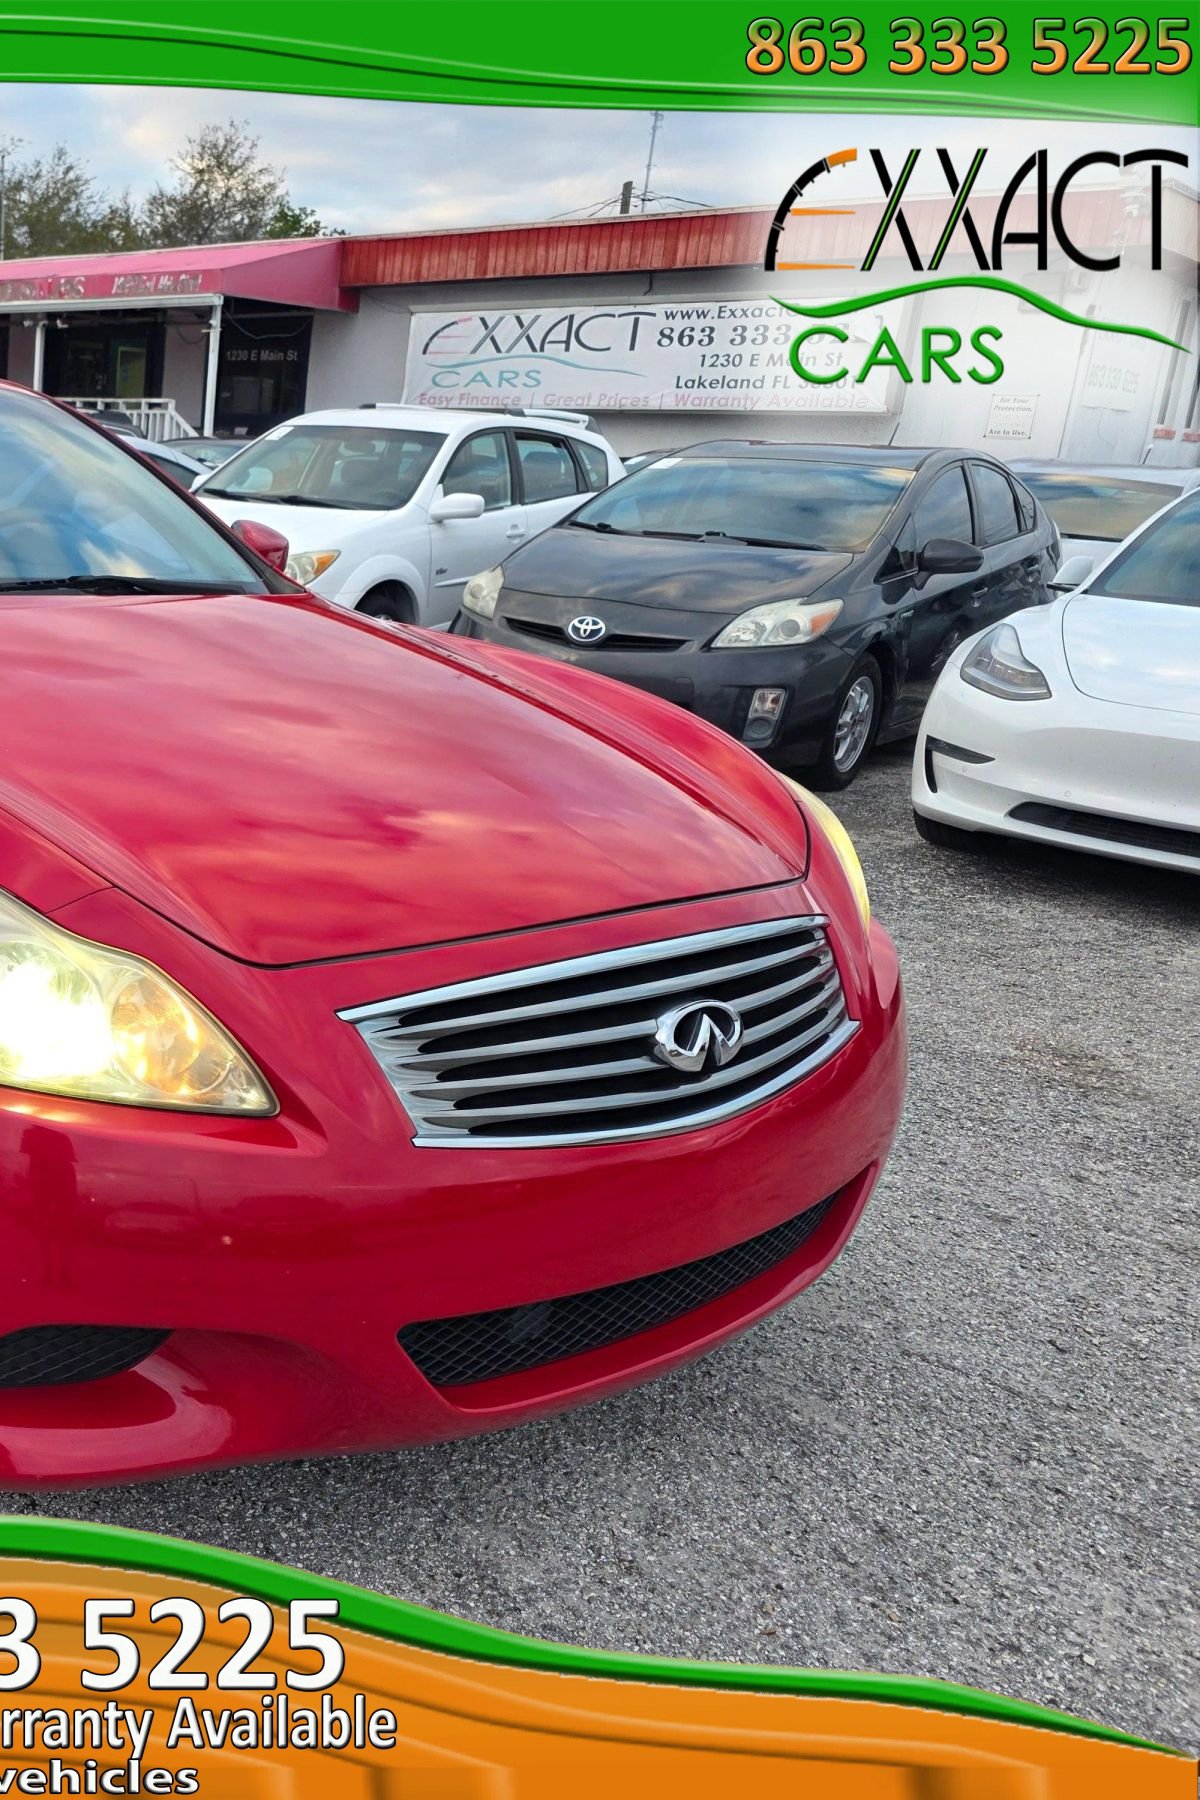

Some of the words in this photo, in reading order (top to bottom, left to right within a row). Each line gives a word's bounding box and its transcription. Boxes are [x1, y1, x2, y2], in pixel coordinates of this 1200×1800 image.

[422, 313, 656, 355] EXXACT
[657, 325, 716, 347] 863
[729, 324, 792, 346] 333
[226, 349, 248, 360] 1230
[251, 349, 257, 360] E
[260, 349, 284, 360] Main
[286, 349, 298, 360] St
[699, 353, 743, 367] 1230
[749, 353, 760, 367] E
[824, 352, 843, 367] St
[431, 370, 542, 388] CARS
[675, 375, 765, 389] Lakeland
[772, 375, 791, 389] FL
[418, 393, 456, 407] Easy
[458, 393, 521, 407] Finance
[543, 393, 593, 407] Great
[597, 393, 649, 408] Prices
[674, 393, 759, 409] Warranty
[768, 392, 869, 408] Available
